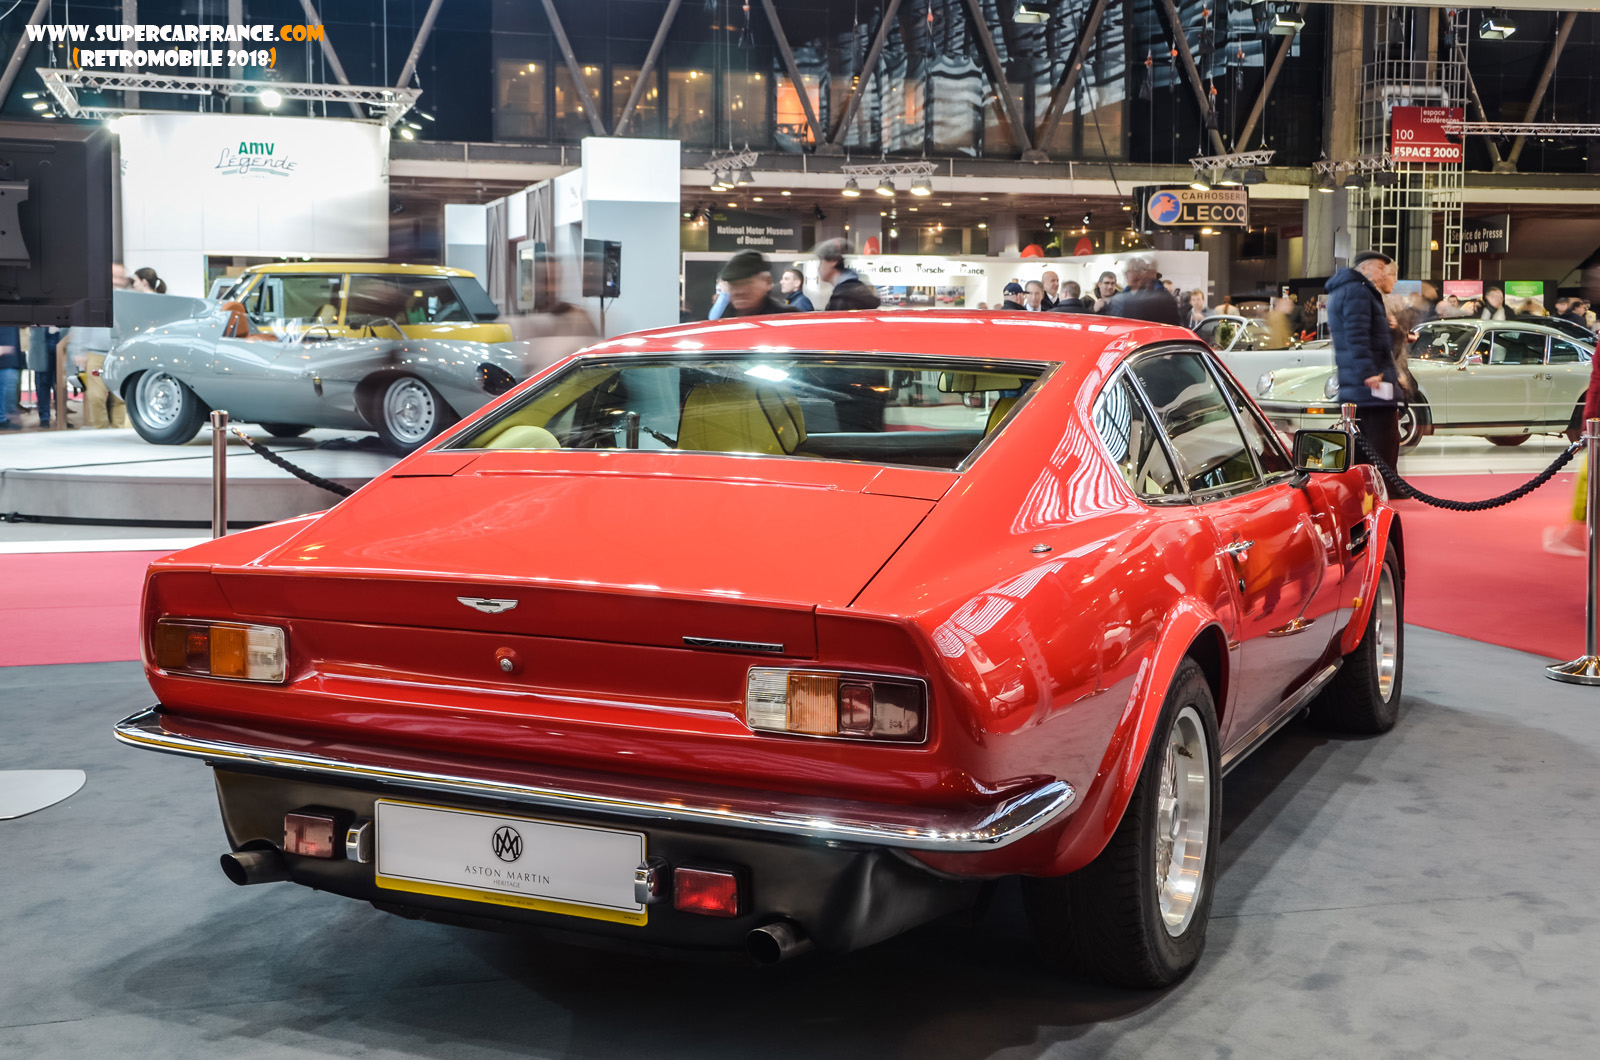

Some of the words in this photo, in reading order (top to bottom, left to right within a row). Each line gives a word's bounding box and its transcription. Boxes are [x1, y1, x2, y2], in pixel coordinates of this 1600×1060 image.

[1423, 109, 1446, 118] espace
[1396, 129, 1414, 140] 100
[1394, 146, 1431, 157] ESPACE
[1433, 147, 1460, 158] 2000
[1181, 192, 1246, 200] CARROSSERIE
[1183, 205, 1246, 223] LECOQ
[717, 225, 745, 235] National
[746, 225, 765, 235] Motor
[766, 226, 794, 236] Museum
[1452, 229, 1473, 241] Seice
[1473, 228, 1482, 240] de
[1482, 227, 1504, 239] Presse
[736, 236, 744, 245] of
[745, 236, 774, 246] Beaulieu
[1464, 241, 1478, 253] Club
[1479, 241, 1489, 253] VIP
[879, 265, 892, 274] des
[960, 266, 985, 275] ance
[464, 864, 501, 878] ASTON
[506, 871, 550, 885] MARTIN
[493, 879, 521, 889] HERITAGE
